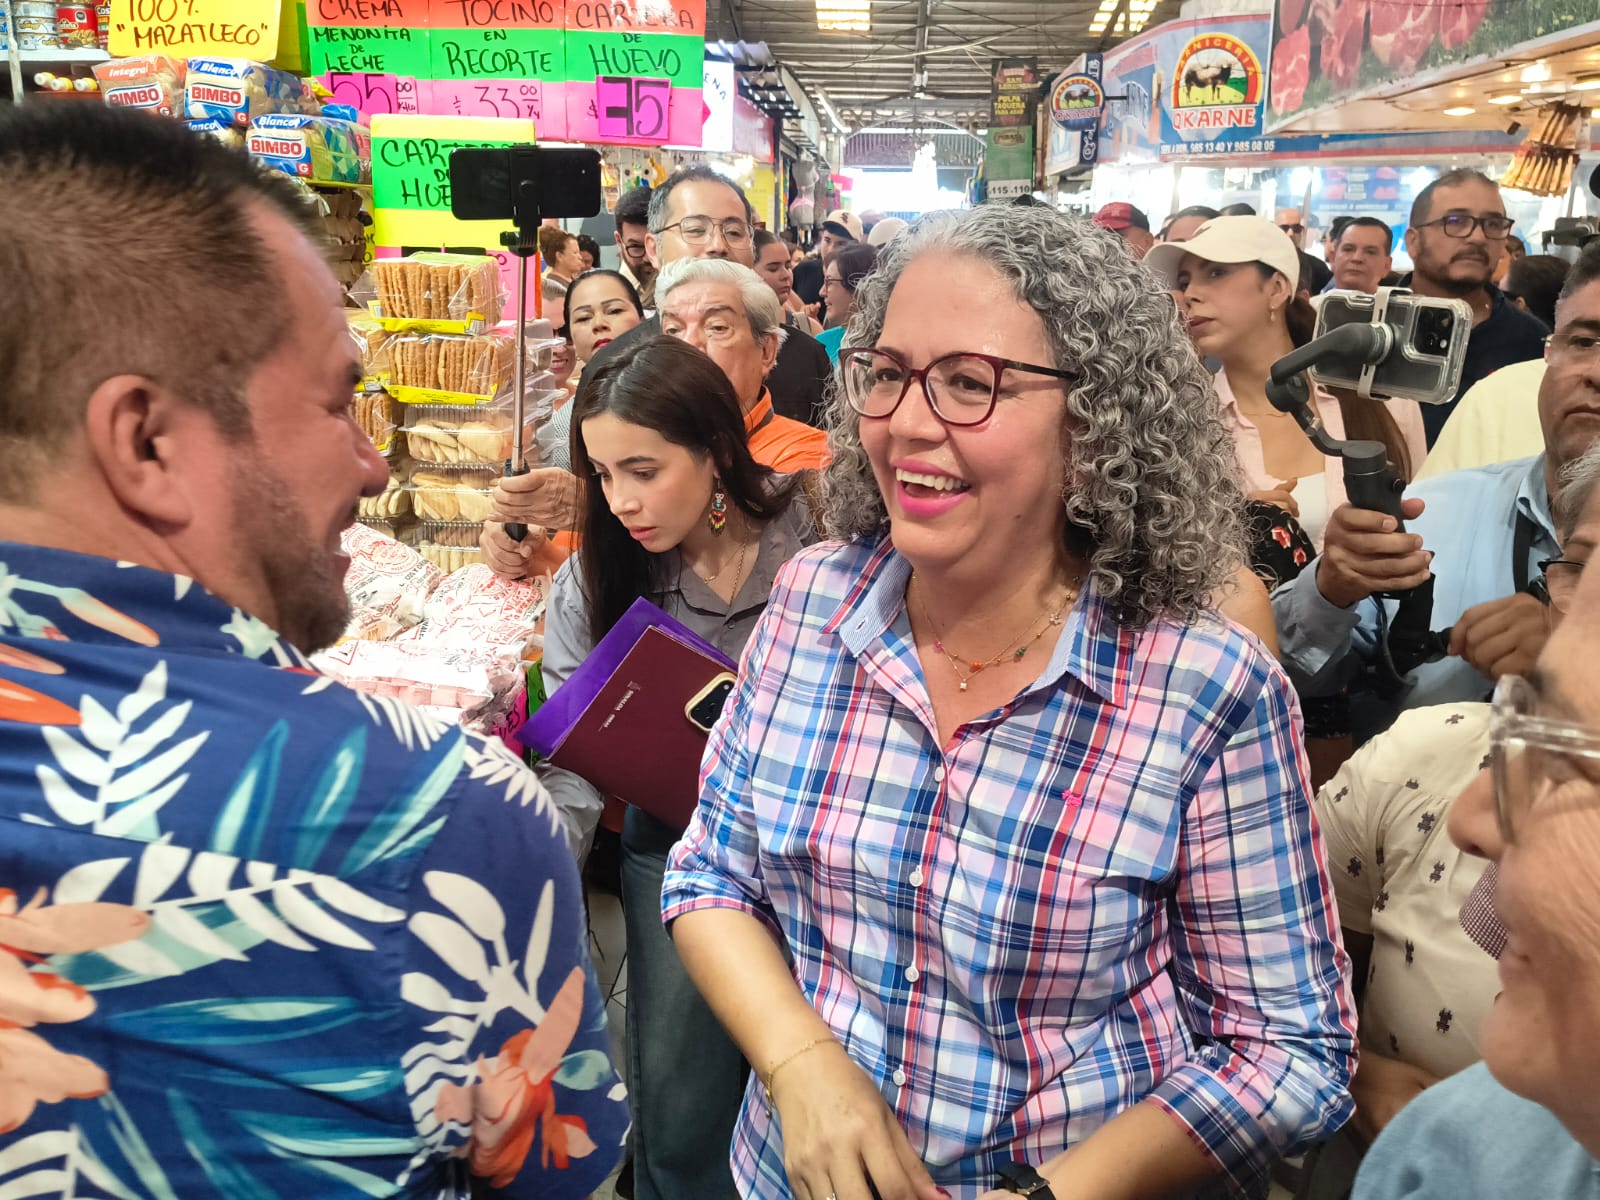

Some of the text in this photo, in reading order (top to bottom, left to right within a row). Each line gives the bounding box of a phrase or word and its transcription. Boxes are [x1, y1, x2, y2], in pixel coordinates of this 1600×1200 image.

[318, 0, 403, 20] CREMA
[444, 0, 554, 26] TOCINO
[484, 29, 507, 41] EN
[623, 33, 642, 43] DE
[325, 53, 385, 71] LECHE
[441, 41, 553, 77] RECORTE
[588, 44, 681, 76] HUEVO
[109, 64, 149, 77] Integral
[199, 62, 237, 76] Blanco
[108, 87, 160, 106] BIMBO
[191, 86, 242, 105] BIMBO
[474, 86, 520, 118] 33
[520, 85, 537, 95] 00
[602, 76, 669, 137] 75
[189, 120, 216, 131] lanco
[237, 112, 247, 122] G
[251, 138, 302, 155] BIMBO
[299, 163, 309, 173] G
[401, 178, 451, 207] HUE
